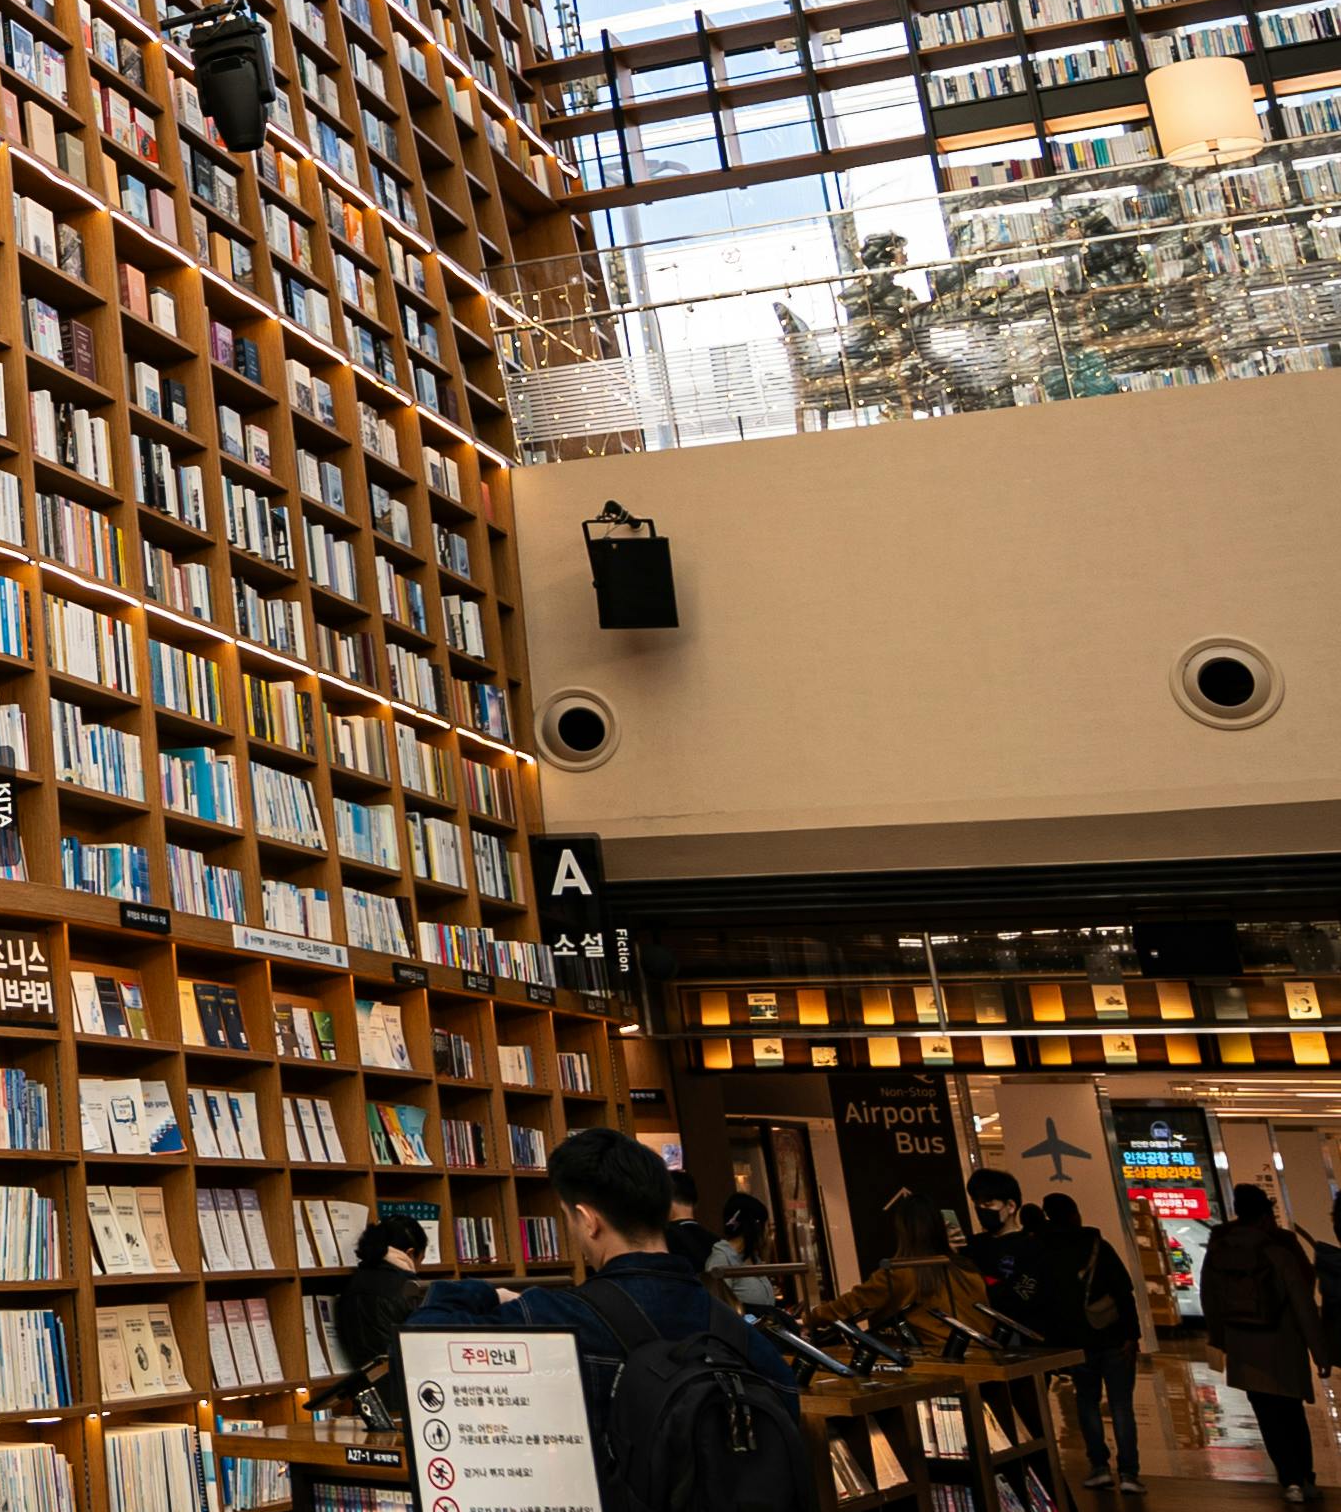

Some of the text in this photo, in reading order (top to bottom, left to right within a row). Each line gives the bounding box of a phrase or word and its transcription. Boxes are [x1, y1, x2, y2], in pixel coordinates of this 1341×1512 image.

[550, 848, 592, 896] A
[553, 932, 605, 959] 소설
[616, 928, 629, 972] Fiction
[880, 1086, 936, 1098] Non-Stop
[845, 1101, 941, 1129] Airport
[895, 1132, 946, 1154] Bus
[1123, 1151, 1170, 1165] 인천공항
[462, 1347, 517, 1366] 주의안내
